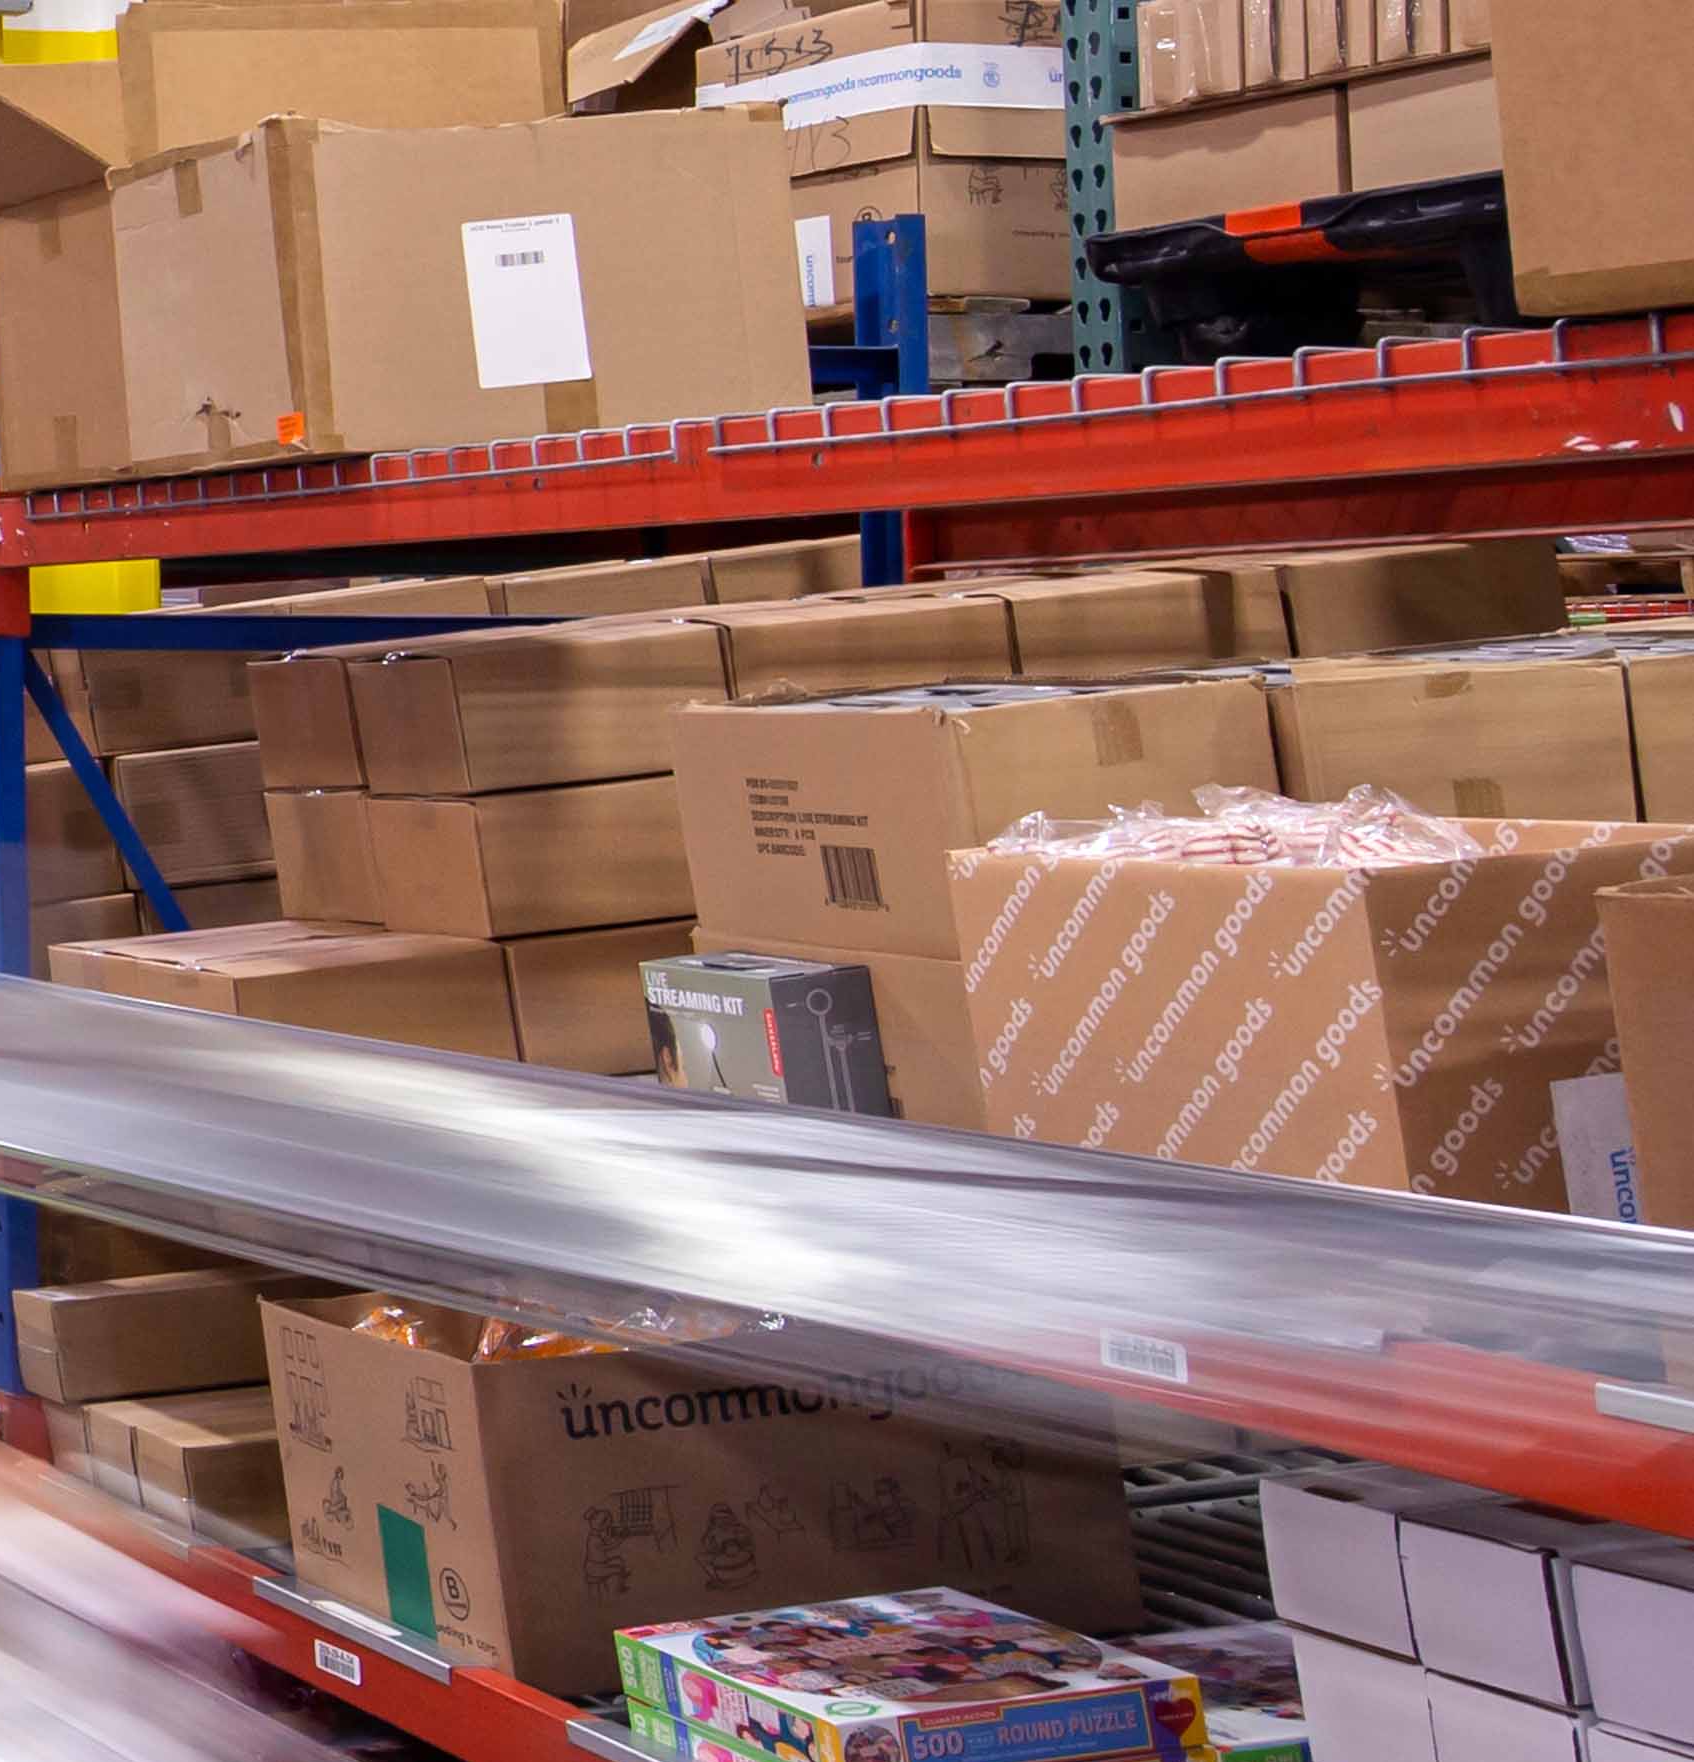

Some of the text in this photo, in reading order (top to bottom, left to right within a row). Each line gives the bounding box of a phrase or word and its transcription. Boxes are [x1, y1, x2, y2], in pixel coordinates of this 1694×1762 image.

[644, 971, 667, 988] LIVE
[647, 986, 744, 1017] STREAMING KIT
[1042, 888, 1178, 1096] uncommon goods
[1126, 868, 1275, 1084] uncommon goods
[1394, 922, 1525, 1089] uncommon
[987, 996, 1035, 1075] goods
[1214, 996, 1275, 1083] goods
[1315, 977, 1384, 1070] goods
[1430, 1076, 1505, 1176] goods
[622, 1645, 638, 1690] 500
[911, 1731, 964, 1760] 500
[997, 1719, 1064, 1745] ROUND
[1070, 1711, 1138, 1735] PUZZLE
